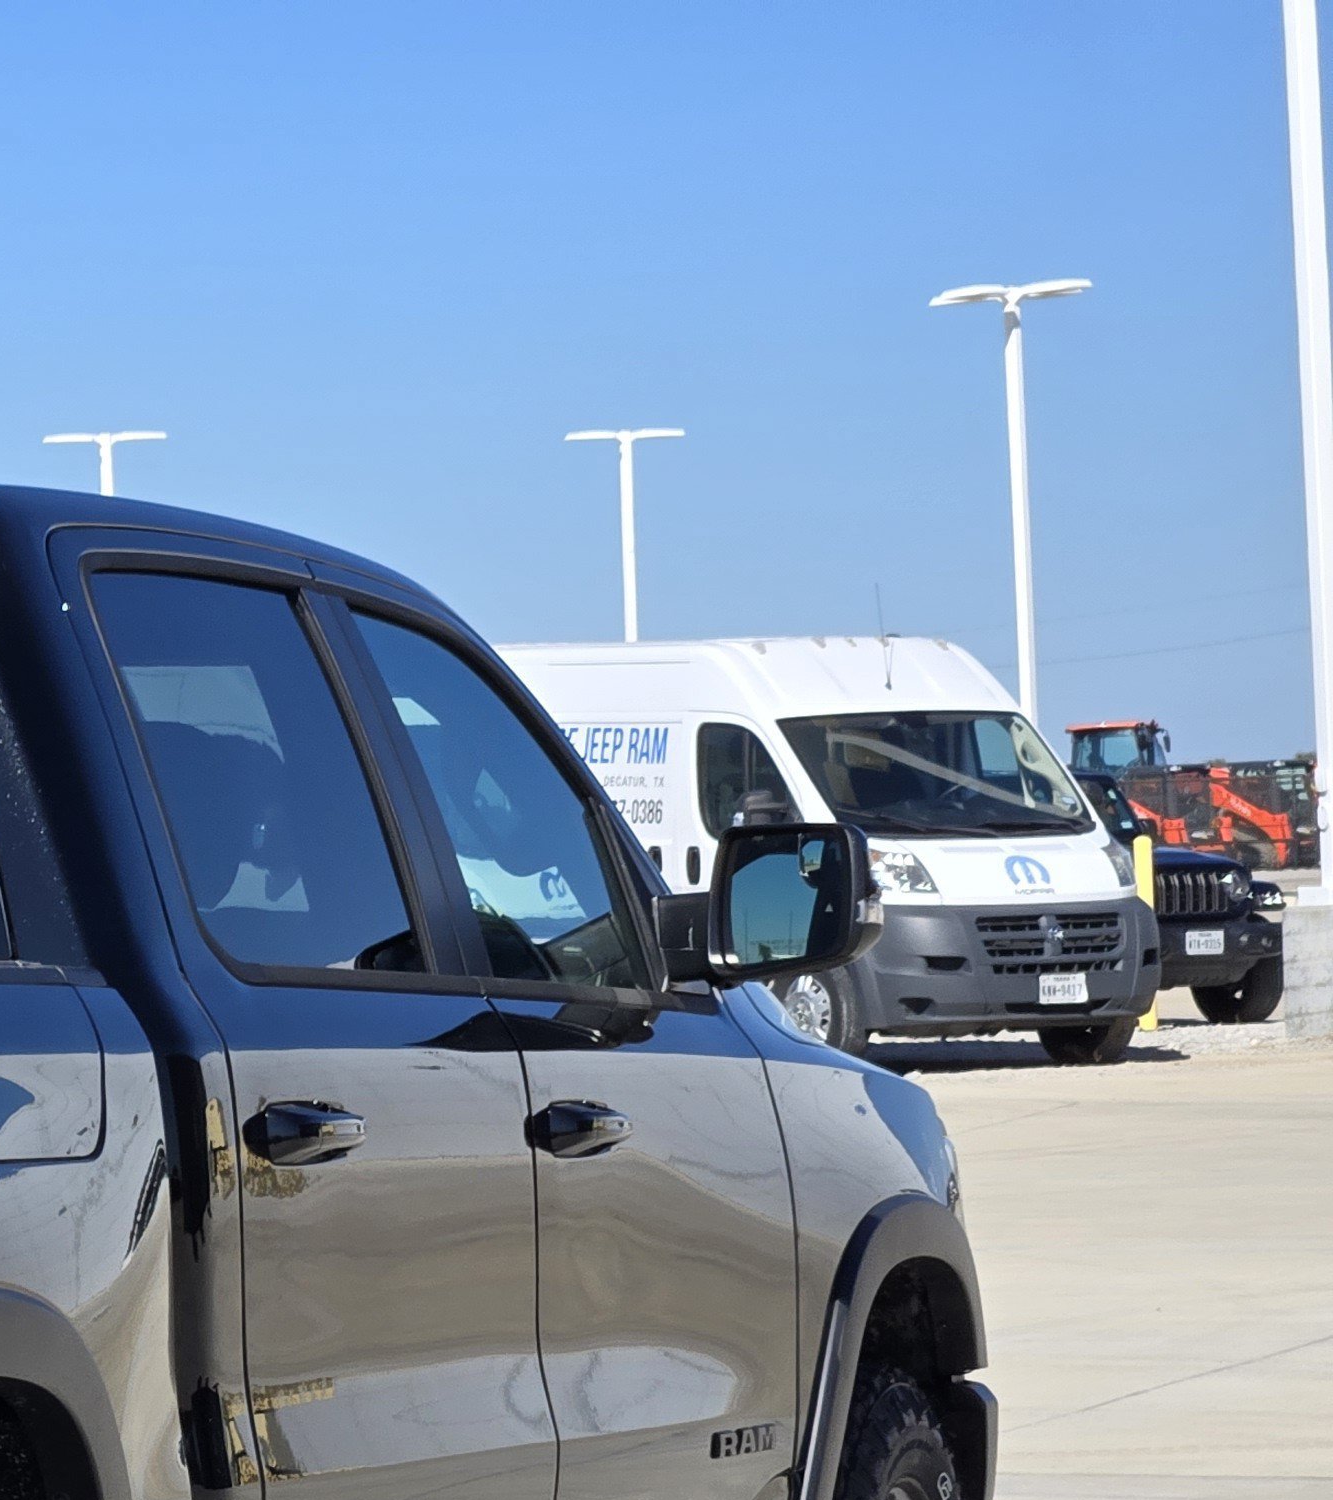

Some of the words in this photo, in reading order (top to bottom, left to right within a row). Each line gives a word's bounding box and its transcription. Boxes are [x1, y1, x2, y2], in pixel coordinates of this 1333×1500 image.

[581, 727, 624, 764] JEEP
[627, 727, 669, 764] RAM
[710, 1422, 777, 1460] RAM
